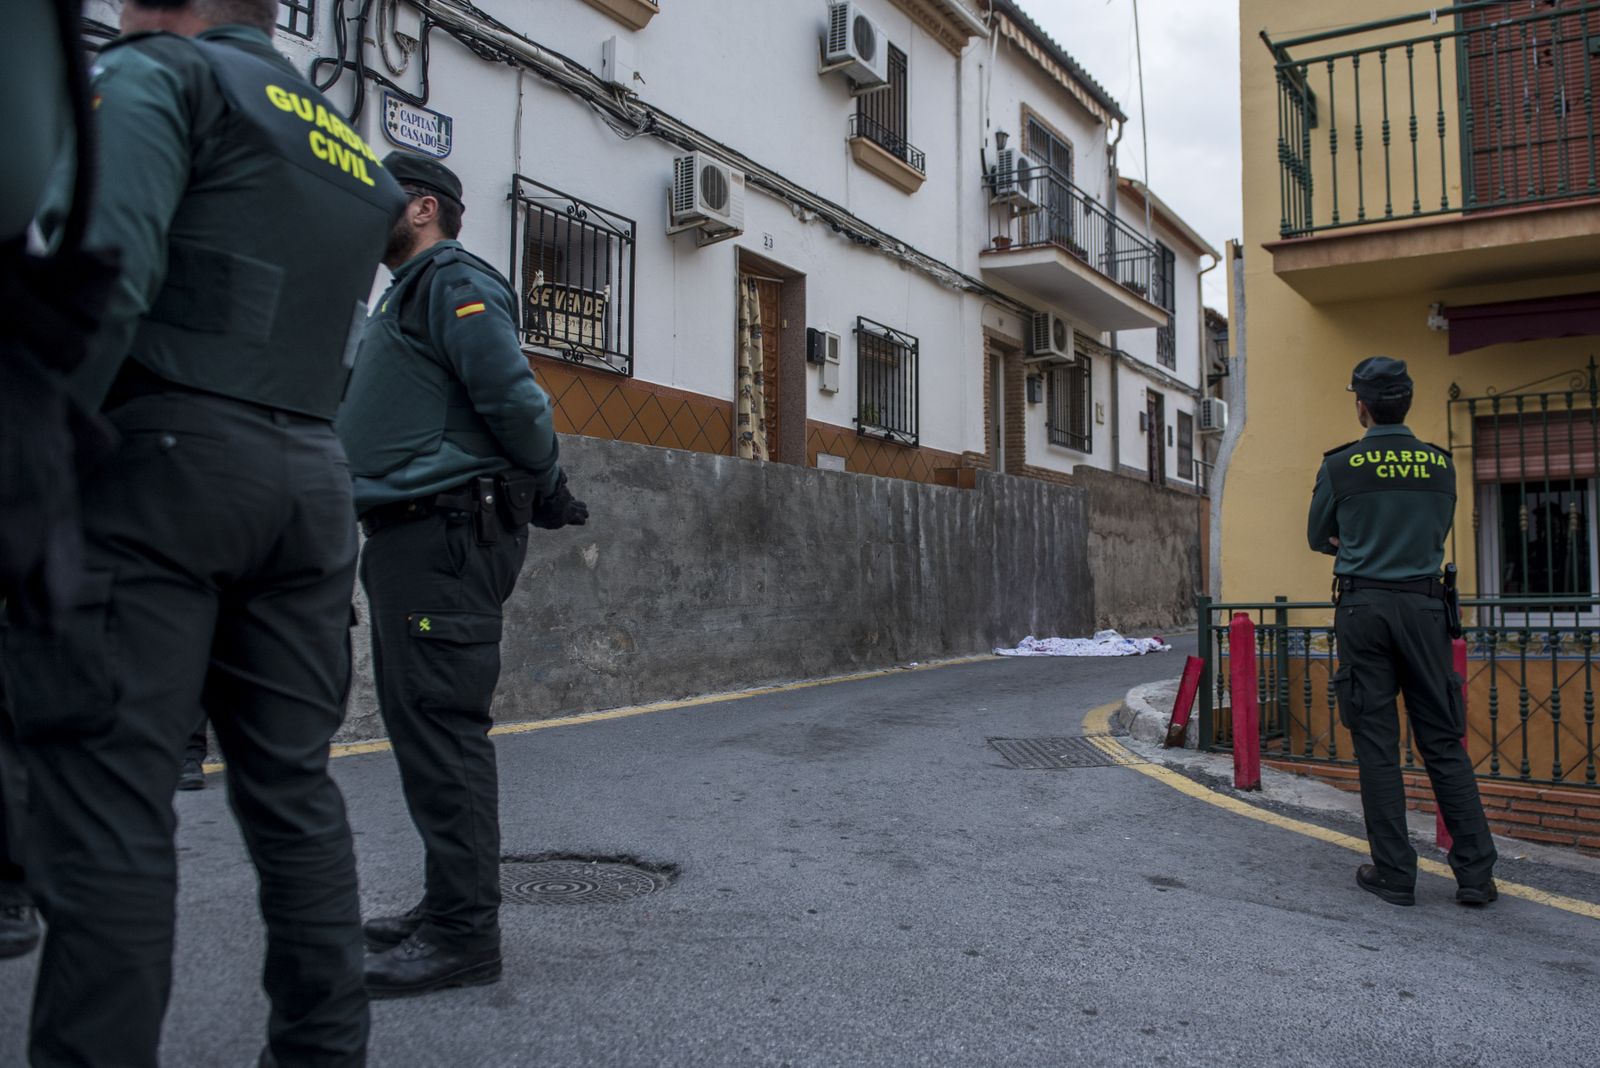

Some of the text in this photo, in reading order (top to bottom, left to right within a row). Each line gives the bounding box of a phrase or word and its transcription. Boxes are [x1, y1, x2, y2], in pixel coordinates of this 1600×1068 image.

[400, 124, 437, 148] CASADO
[309, 130, 375, 187] CIVIL
[763, 234, 775, 249] 23
[529, 286, 553, 308] SE
[1348, 449, 1448, 469] GUARDIA
[1375, 464, 1431, 479] CIVIL
